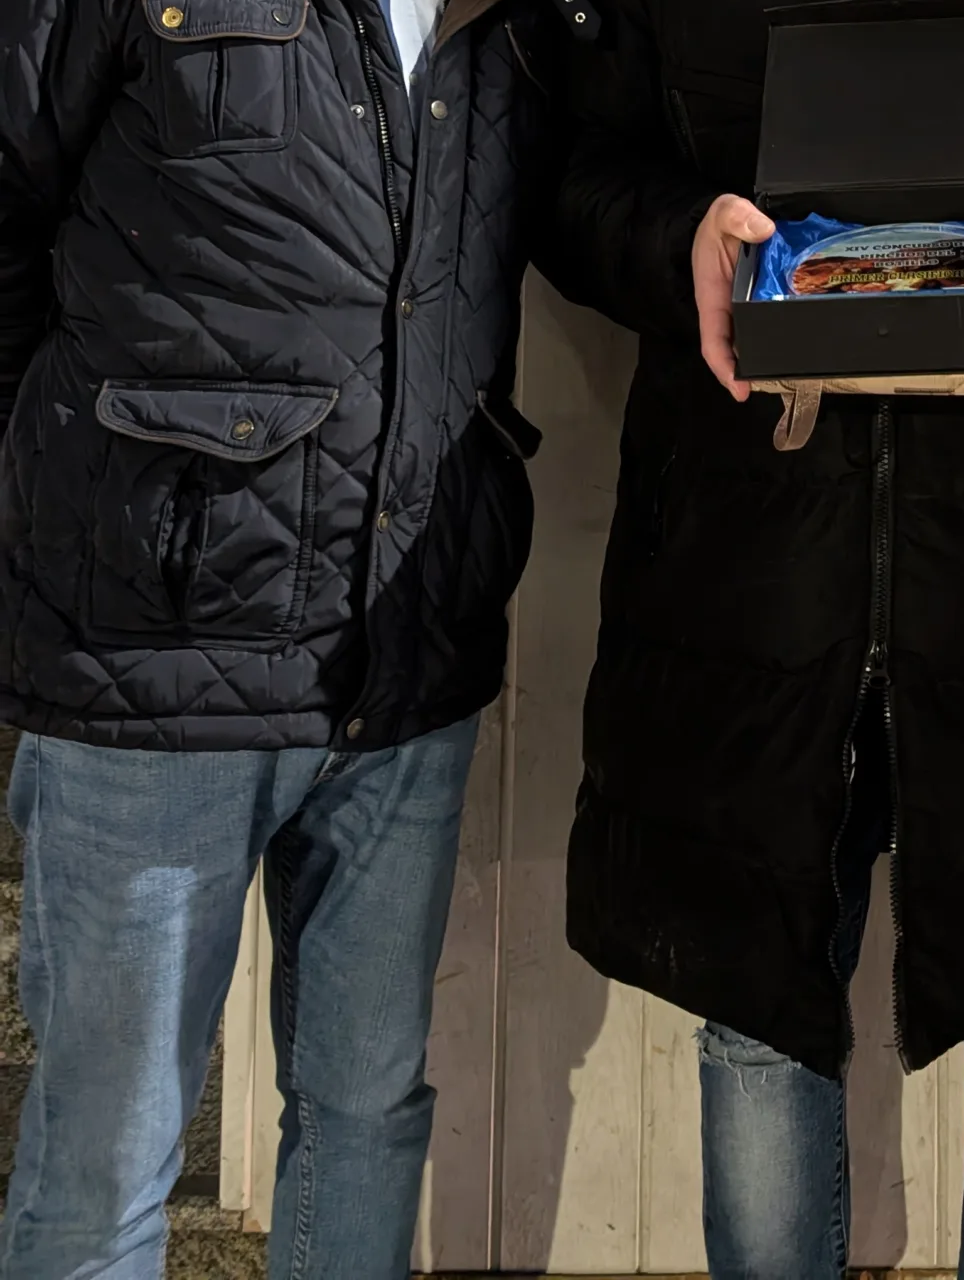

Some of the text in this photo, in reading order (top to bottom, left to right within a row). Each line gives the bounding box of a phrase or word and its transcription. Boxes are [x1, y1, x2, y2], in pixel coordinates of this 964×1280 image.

[872, 241, 951, 251] CONCURSO
[860, 248, 956, 260] PINCHOS DEL
[829, 272, 885, 283] PRIMER
